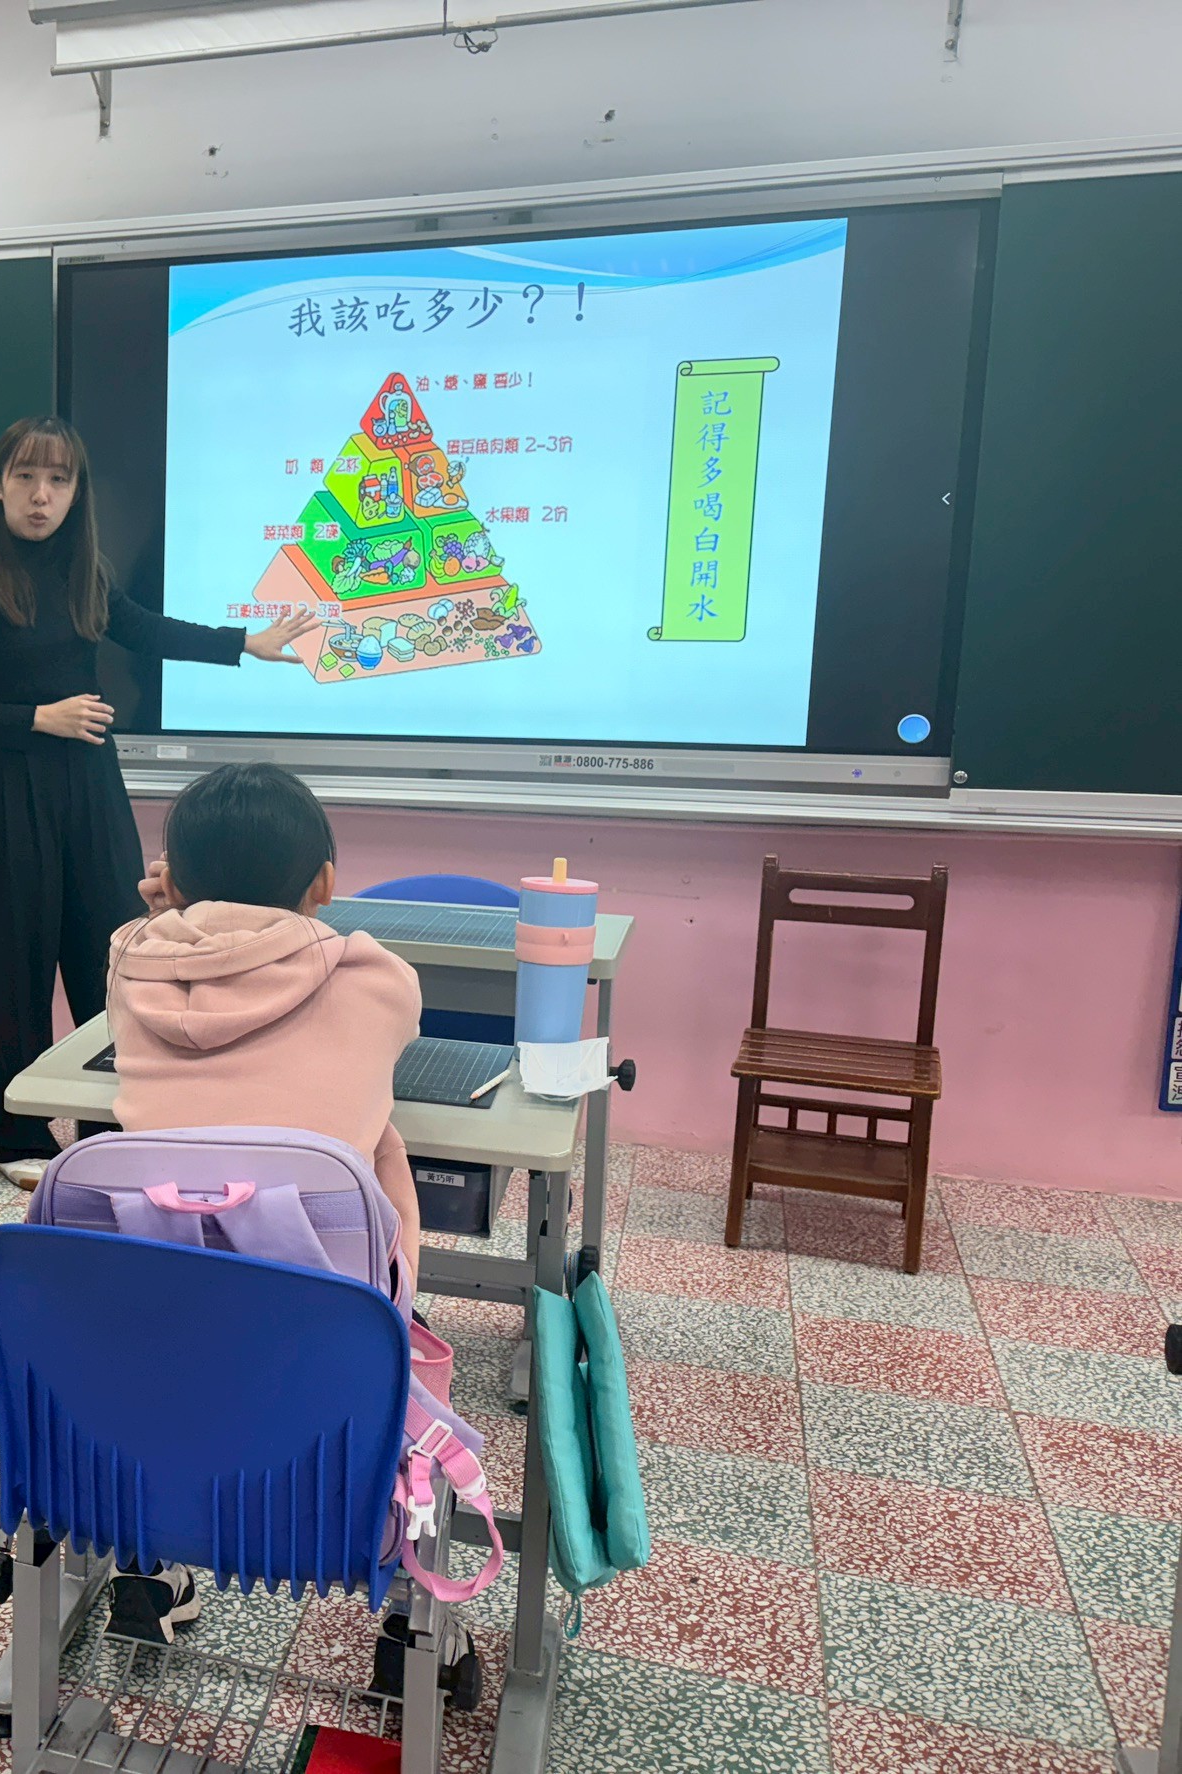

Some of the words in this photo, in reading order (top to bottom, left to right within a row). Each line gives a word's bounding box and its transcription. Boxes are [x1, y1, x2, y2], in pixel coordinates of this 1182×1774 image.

[288, 281, 586, 337] 我該吃多少？！
[525, 436, 573, 453] 2-3份
[485, 506, 530, 523] 水果類
[541, 505, 568, 522] 2份
[686, 390, 732, 622] 記得多喝白開水
